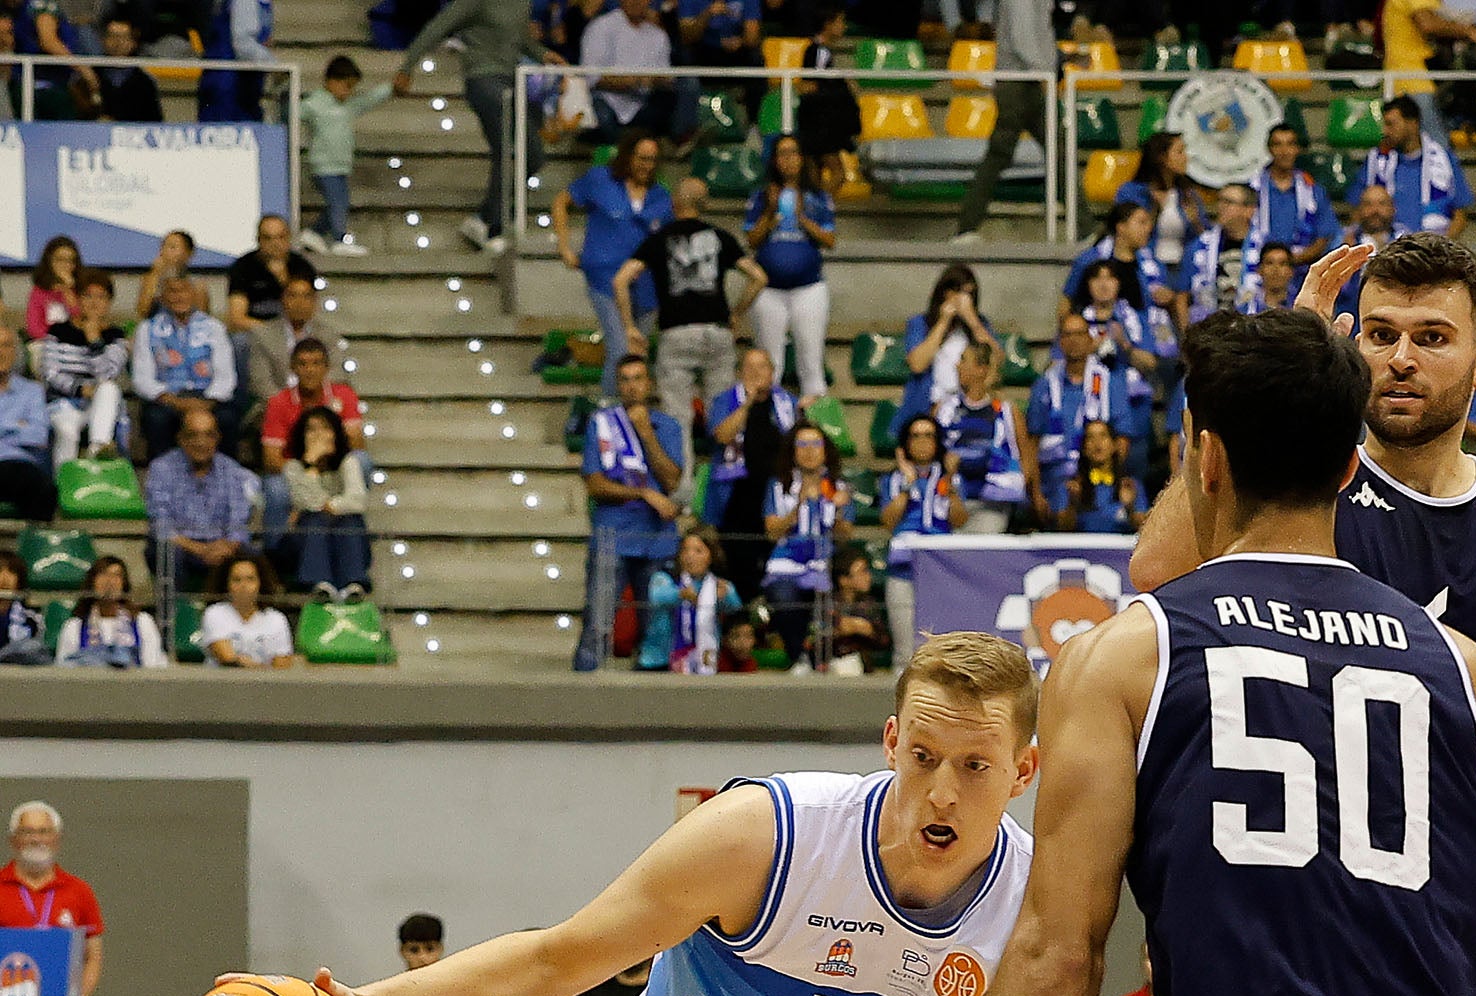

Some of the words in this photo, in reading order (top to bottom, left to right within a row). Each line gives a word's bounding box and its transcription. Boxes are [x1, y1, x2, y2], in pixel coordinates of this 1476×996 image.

[1213, 595, 1409, 650] ALEJANO
[1205, 645, 1431, 892] 50
[807, 914, 885, 936] GIVOVA
[817, 962, 856, 976] BURGOS
